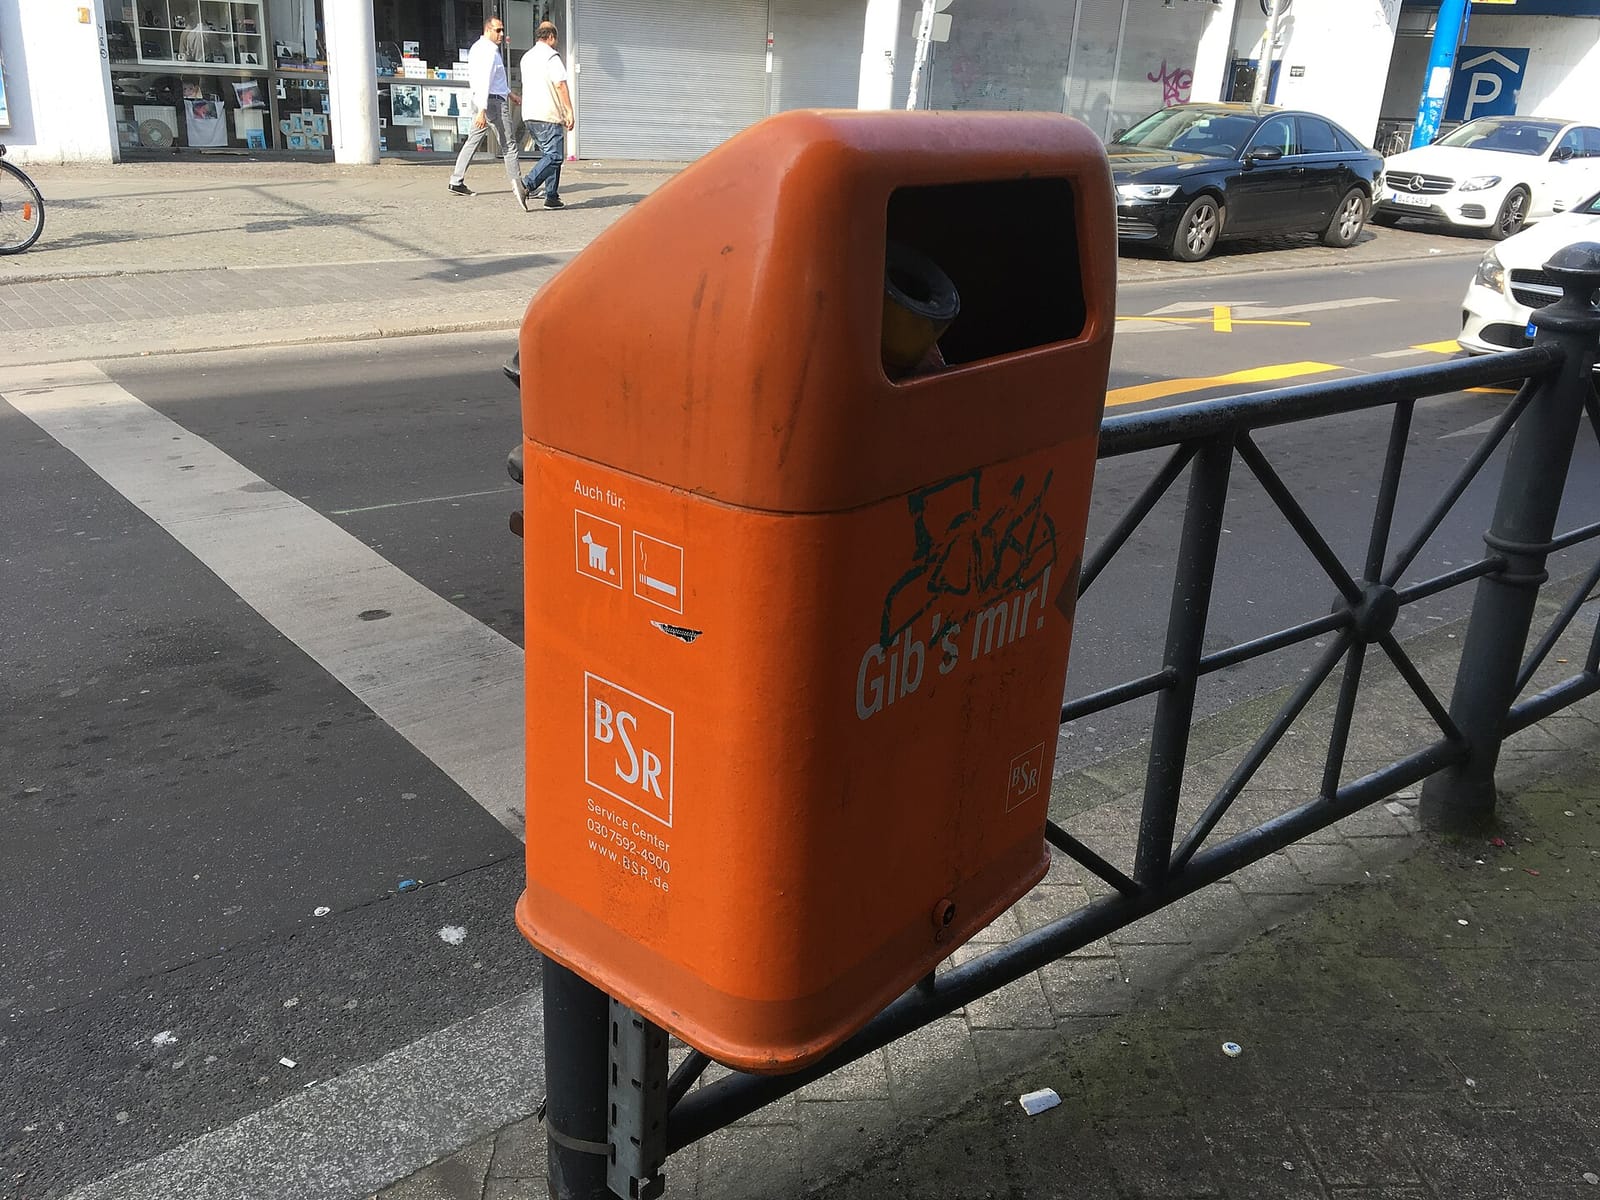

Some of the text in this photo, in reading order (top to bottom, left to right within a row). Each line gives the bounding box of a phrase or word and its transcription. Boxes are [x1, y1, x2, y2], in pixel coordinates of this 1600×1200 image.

[1463, 72, 1503, 121] P
[574, 479, 626, 511] Auch für:
[971, 565, 1051, 661] mir!
[593, 698, 664, 801] BSR
[1011, 760, 1038, 796] BSR
[587, 798, 671, 853] Service Center
[588, 839, 670, 893] www.BSR.de
